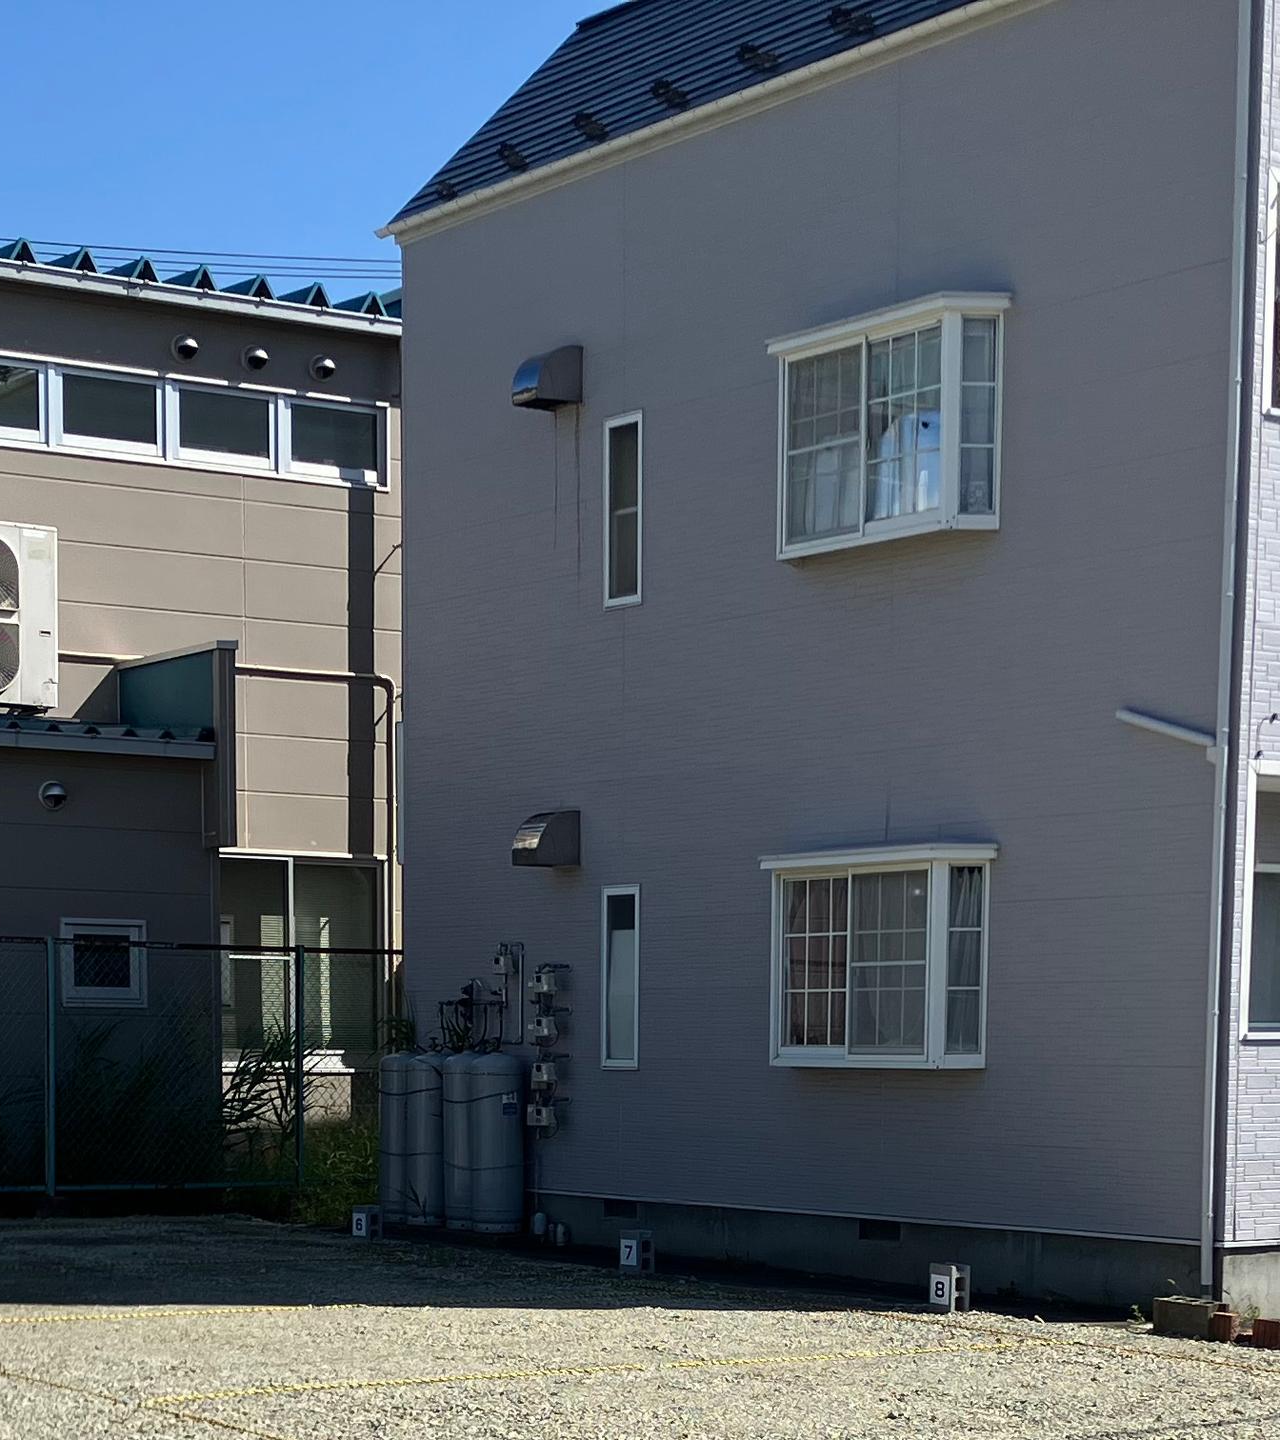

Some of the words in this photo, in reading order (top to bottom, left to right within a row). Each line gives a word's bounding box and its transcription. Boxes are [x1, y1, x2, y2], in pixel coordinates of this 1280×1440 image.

[355, 1217, 363, 1231] 6
[624, 1244, 633, 1260] 7
[934, 1280, 945, 1299] 8
